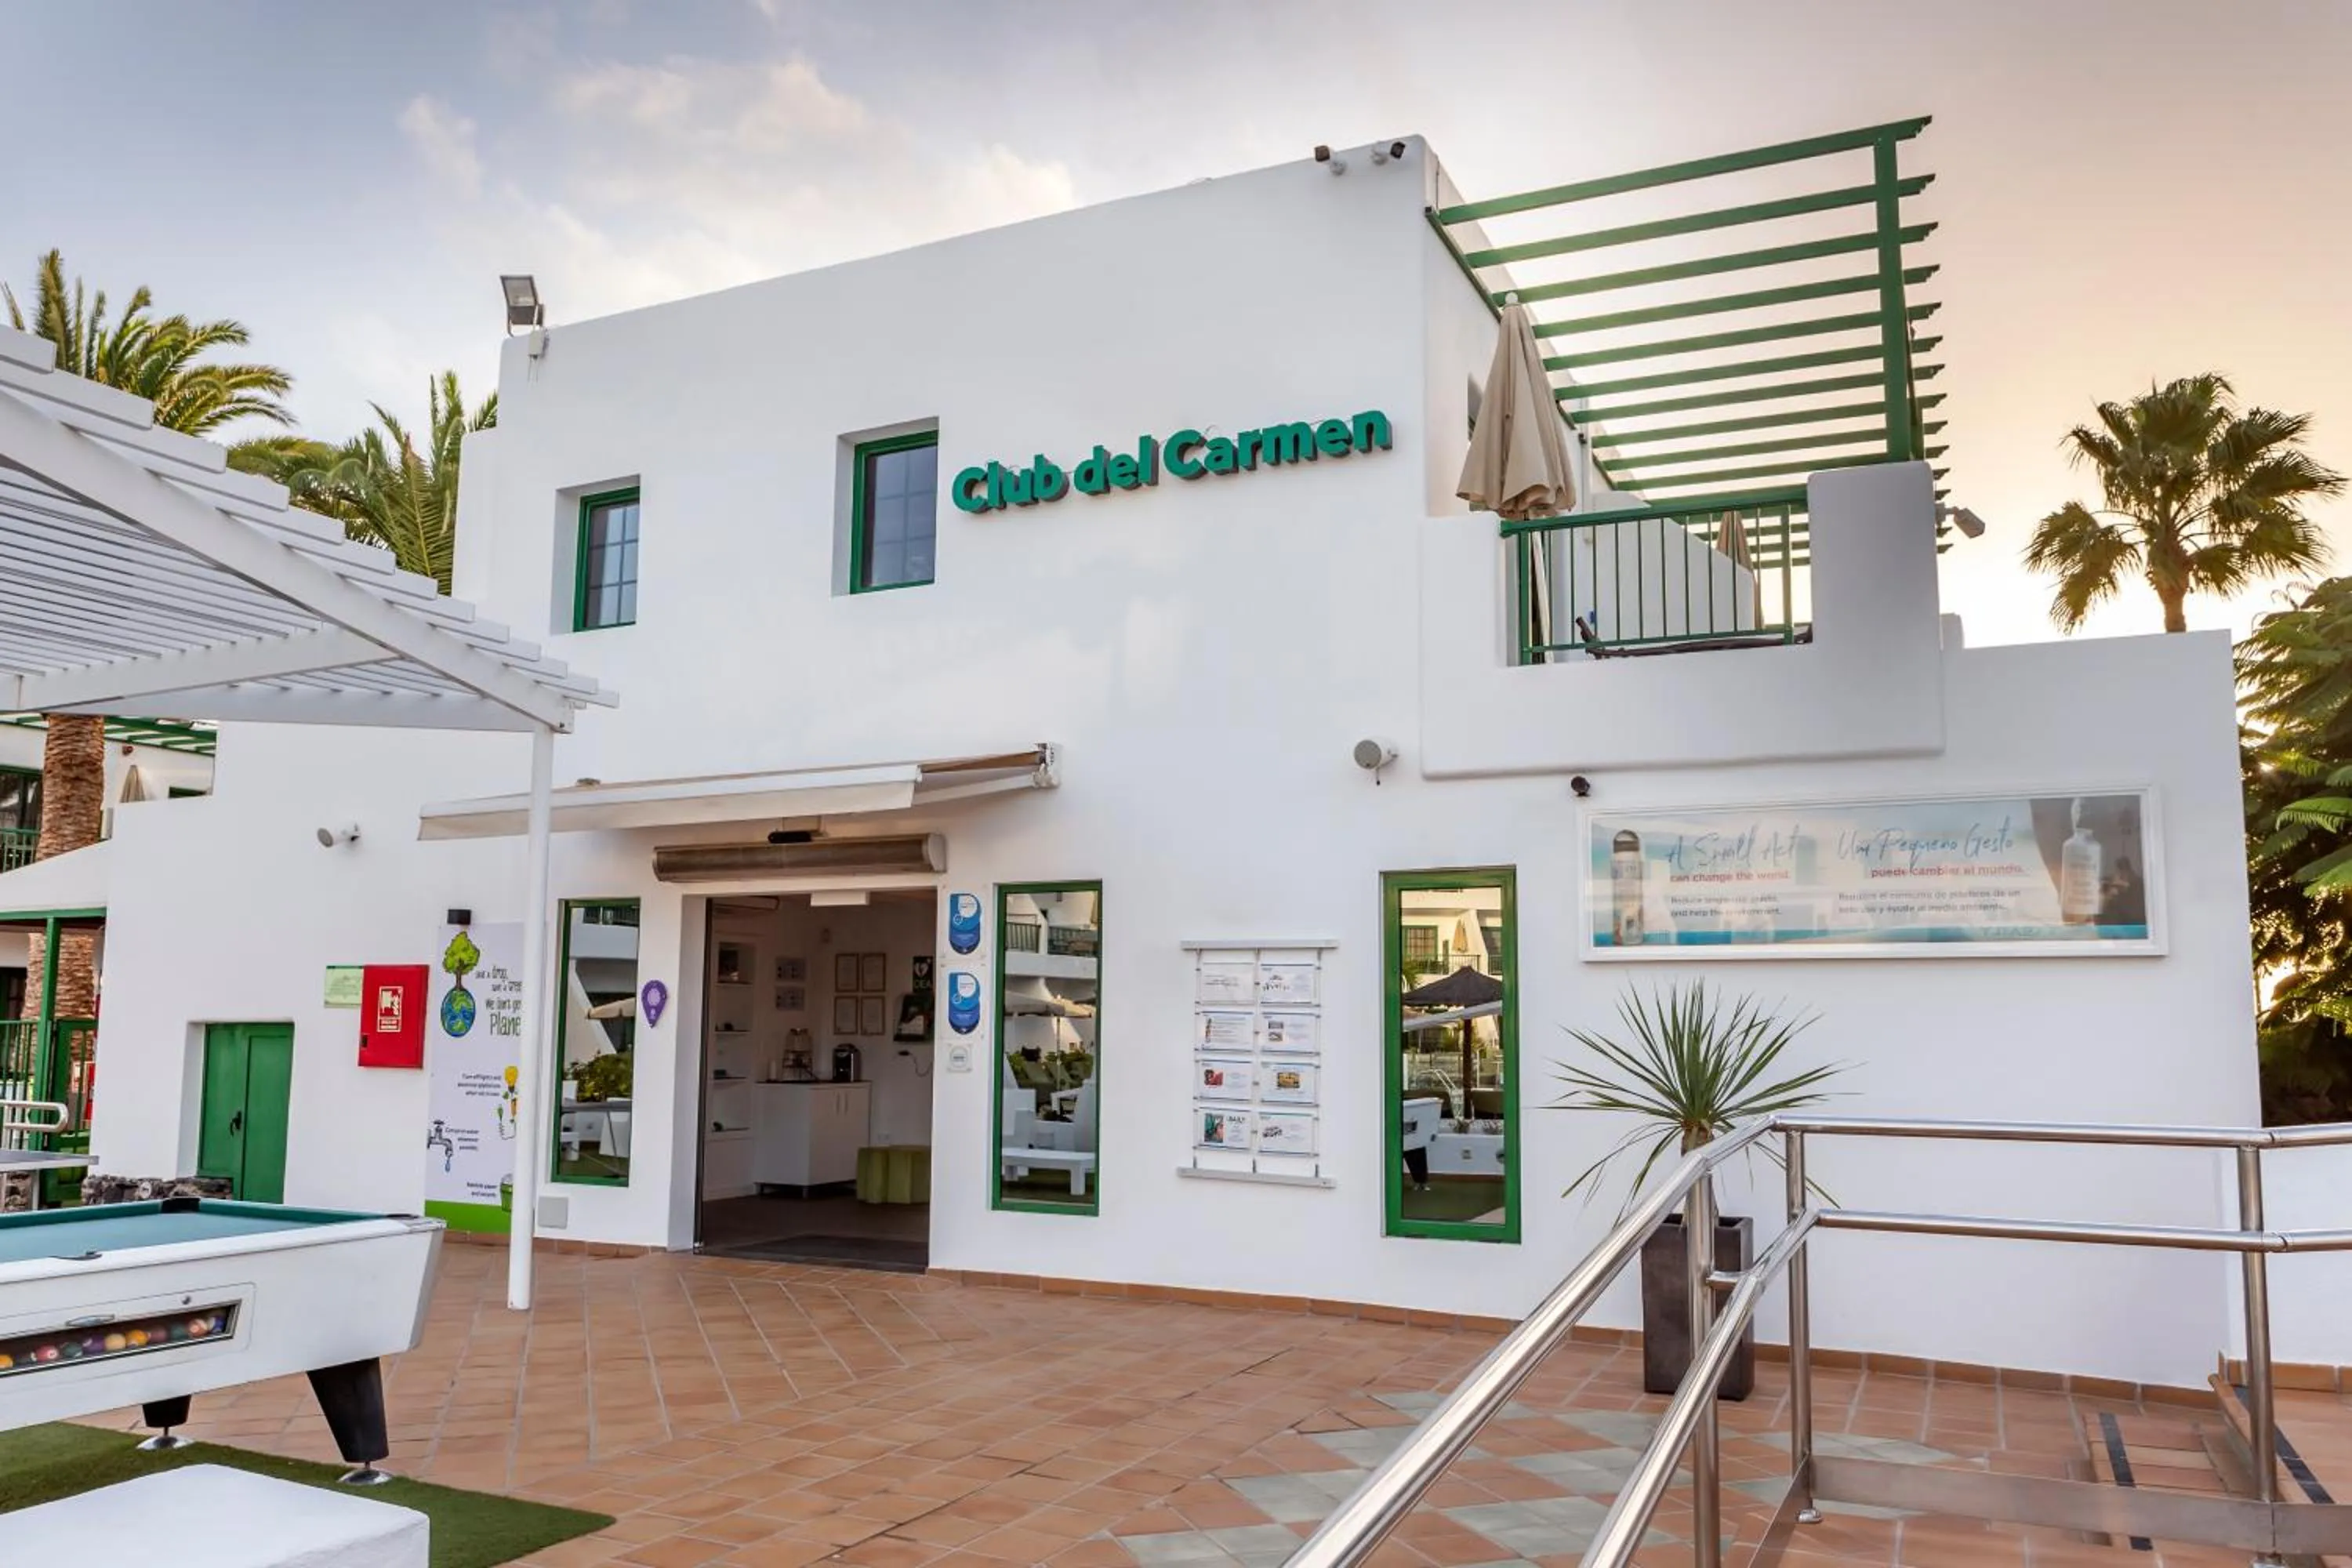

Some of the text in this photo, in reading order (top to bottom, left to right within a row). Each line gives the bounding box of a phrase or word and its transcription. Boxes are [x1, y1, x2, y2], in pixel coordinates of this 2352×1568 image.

[952, 410, 1393, 514] Club del Carmen
[1665, 823, 1800, 870] A Small Act
[1964, 815, 2013, 858] Gesto
[1670, 869, 1791, 884] can change the world.
[1871, 863, 2025, 878] puede cambiar el mundo.
[489, 1011, 521, 1036] Plane
